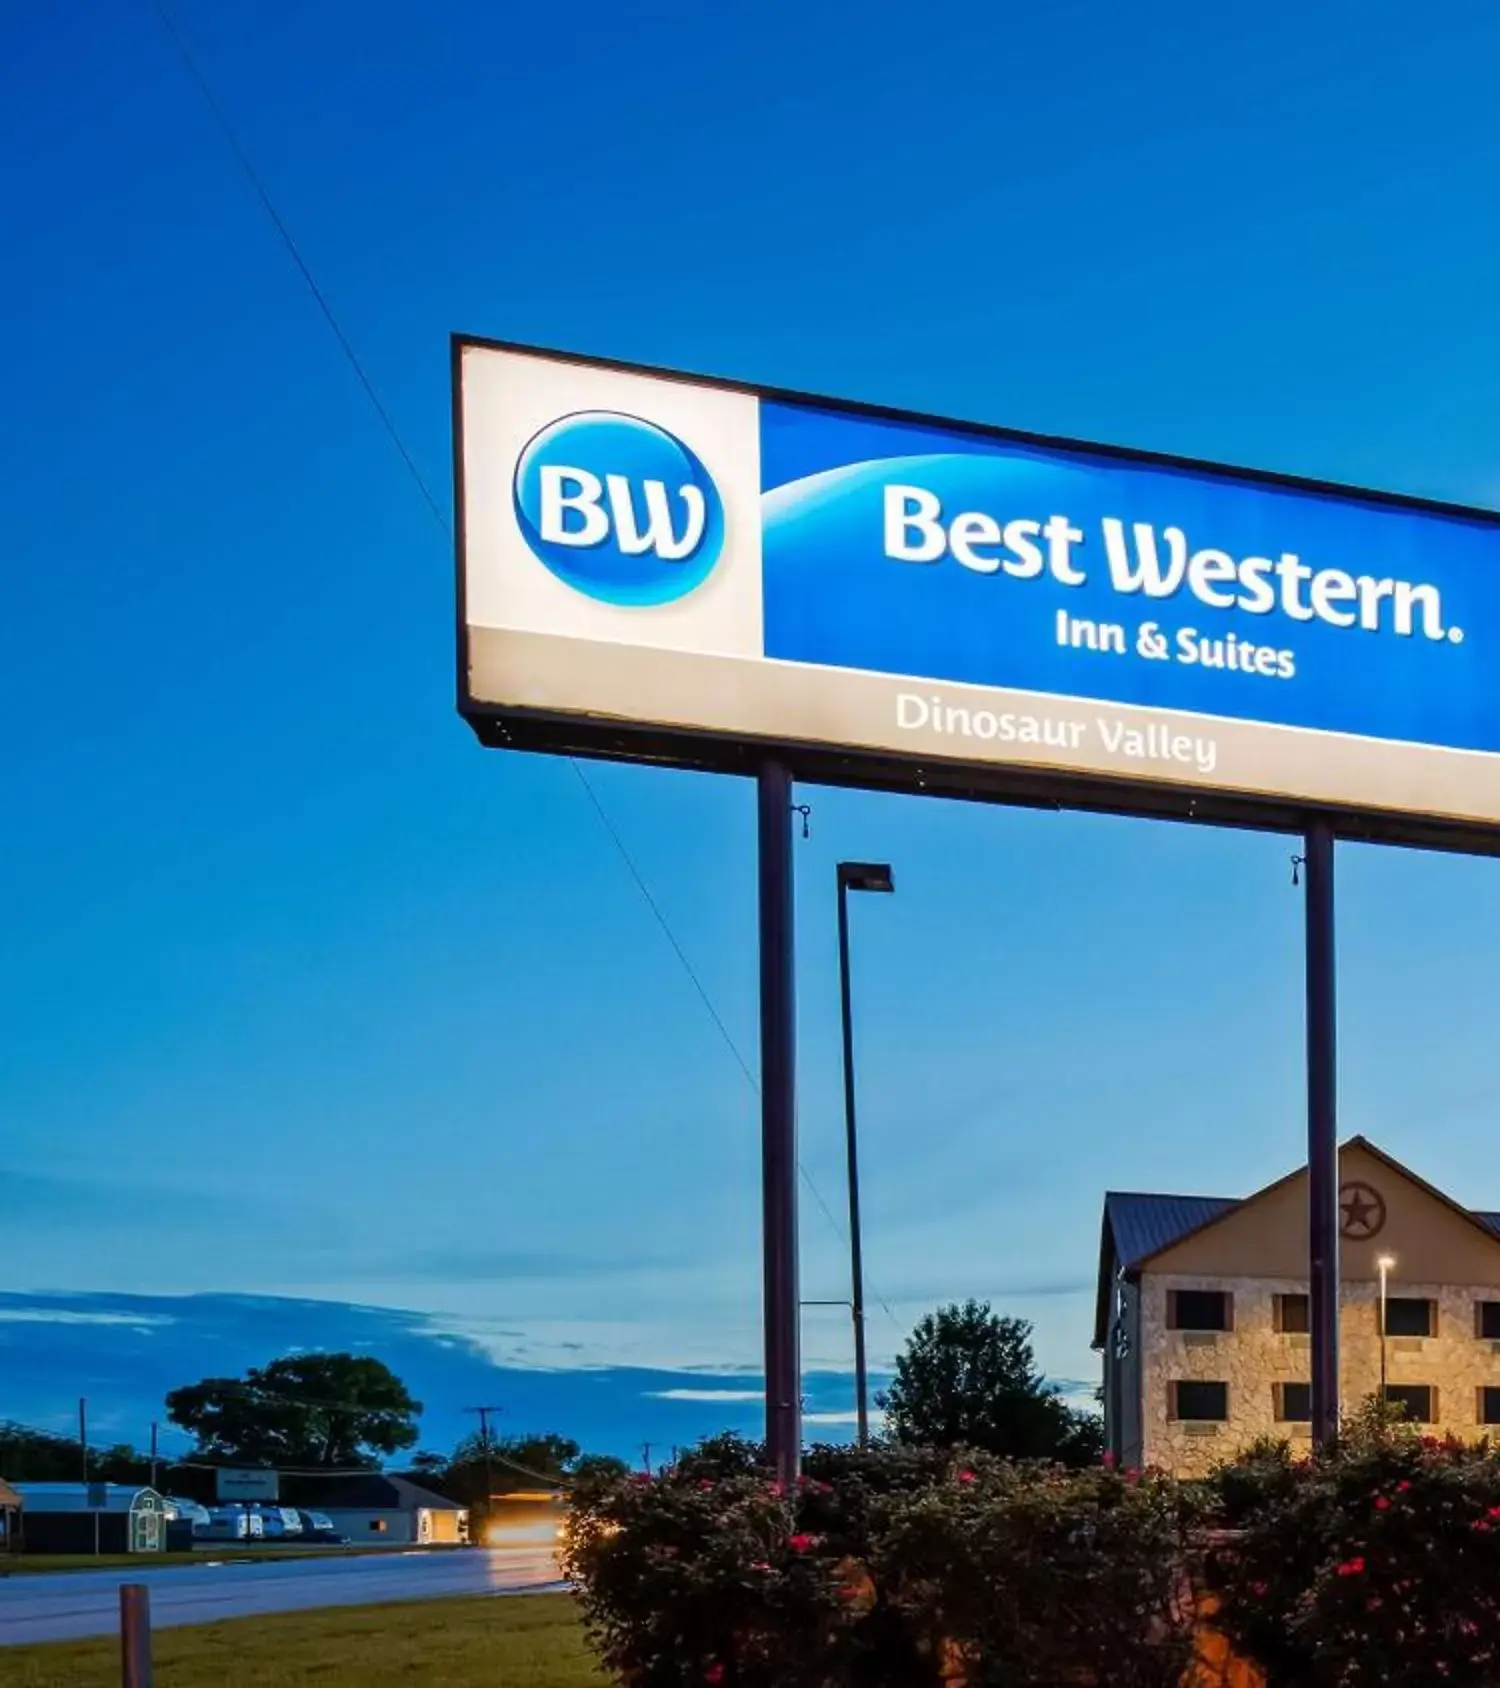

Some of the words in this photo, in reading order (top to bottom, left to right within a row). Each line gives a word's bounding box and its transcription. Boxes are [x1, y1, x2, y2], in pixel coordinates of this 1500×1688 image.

[539, 464, 706, 561] BW
[883, 484, 1087, 586] Best
[1056, 608, 1127, 654] Inn
[1136, 621, 1170, 661] &
[1176, 627, 1296, 679] Suites
[895, 693, 1087, 749] Dinosaur
[1096, 718, 1217, 773] Valley
